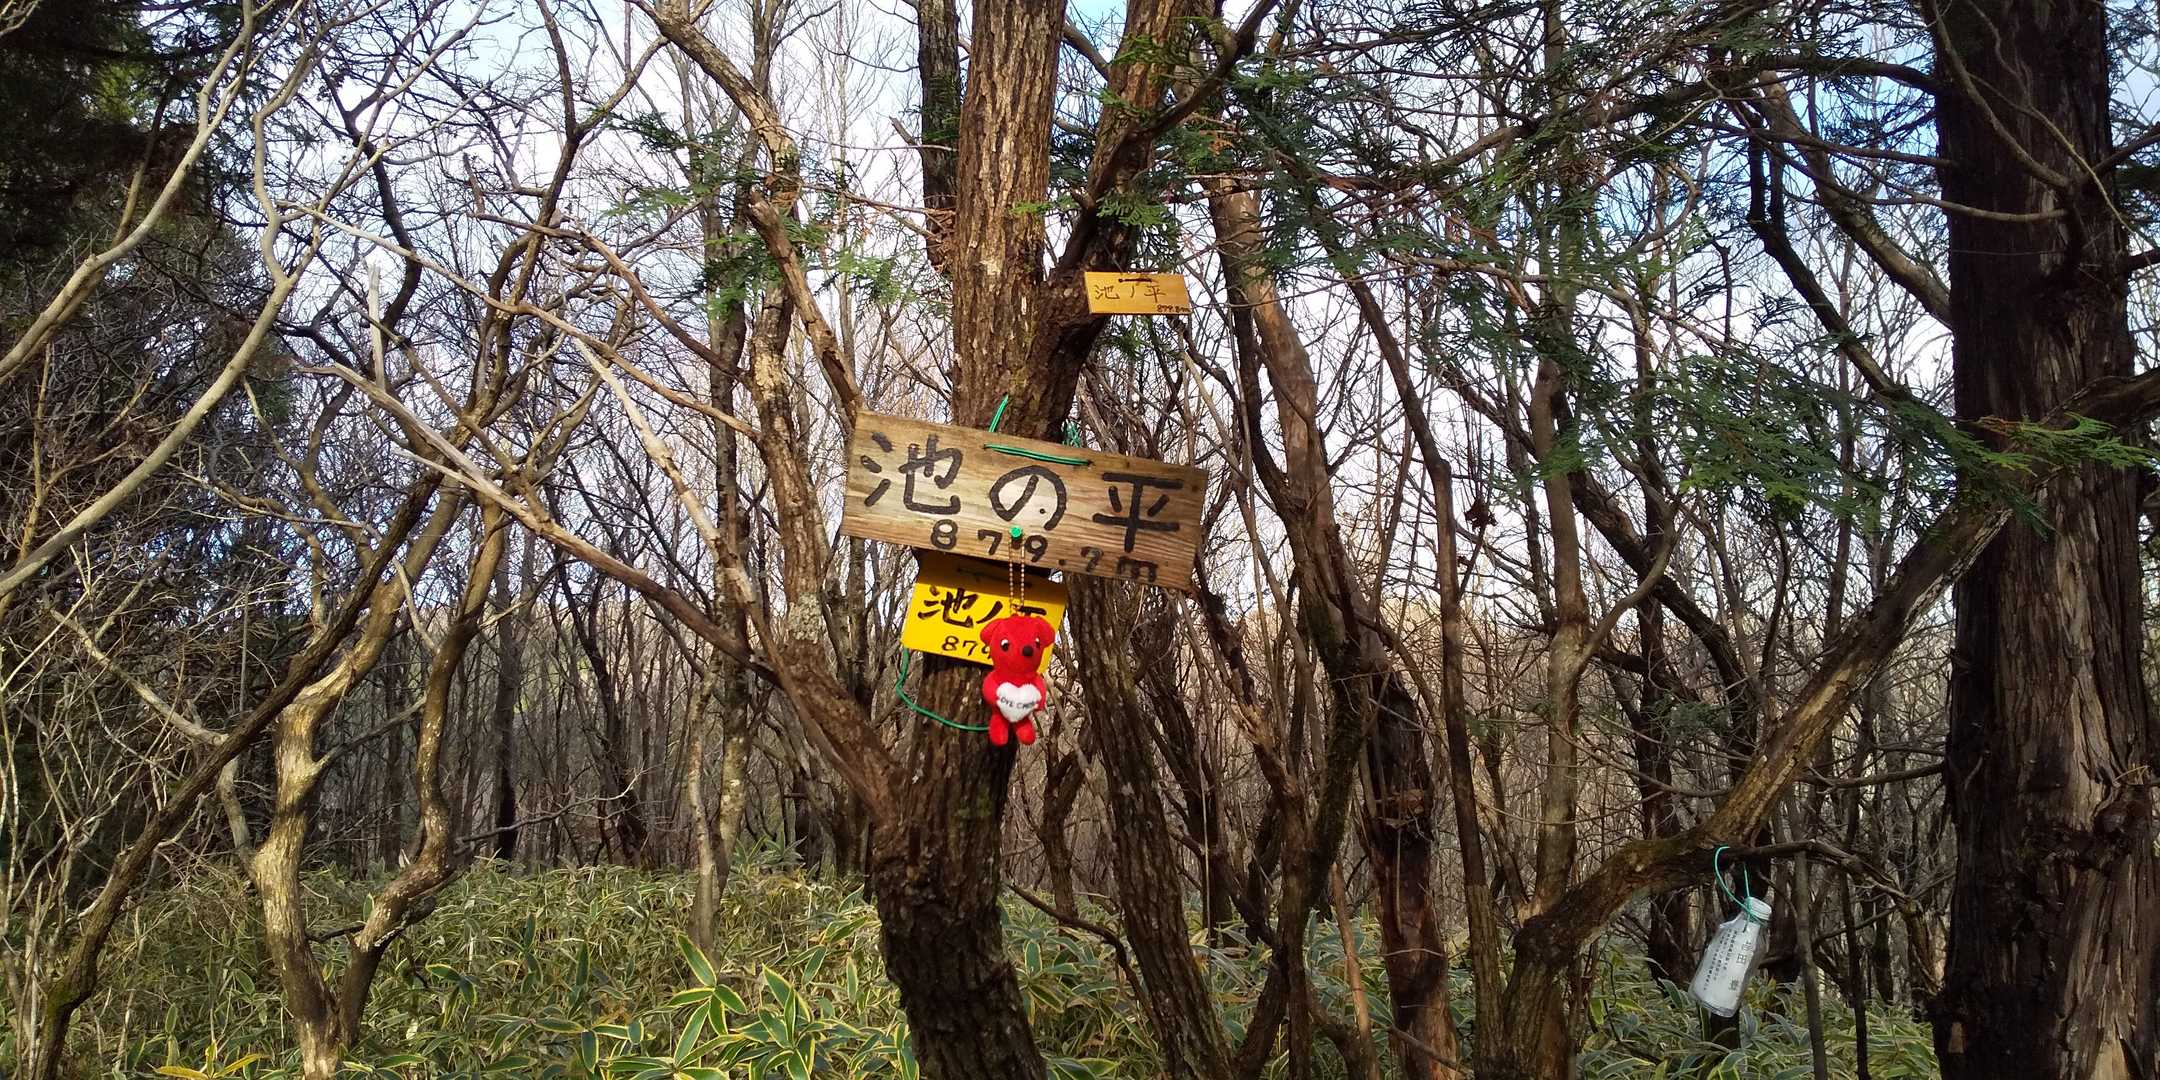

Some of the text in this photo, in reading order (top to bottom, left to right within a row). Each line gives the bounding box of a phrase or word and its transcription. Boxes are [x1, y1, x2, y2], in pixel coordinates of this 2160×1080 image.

[860, 431, 1184, 553] 池の平
[917, 587, 1048, 629] 池ノ
